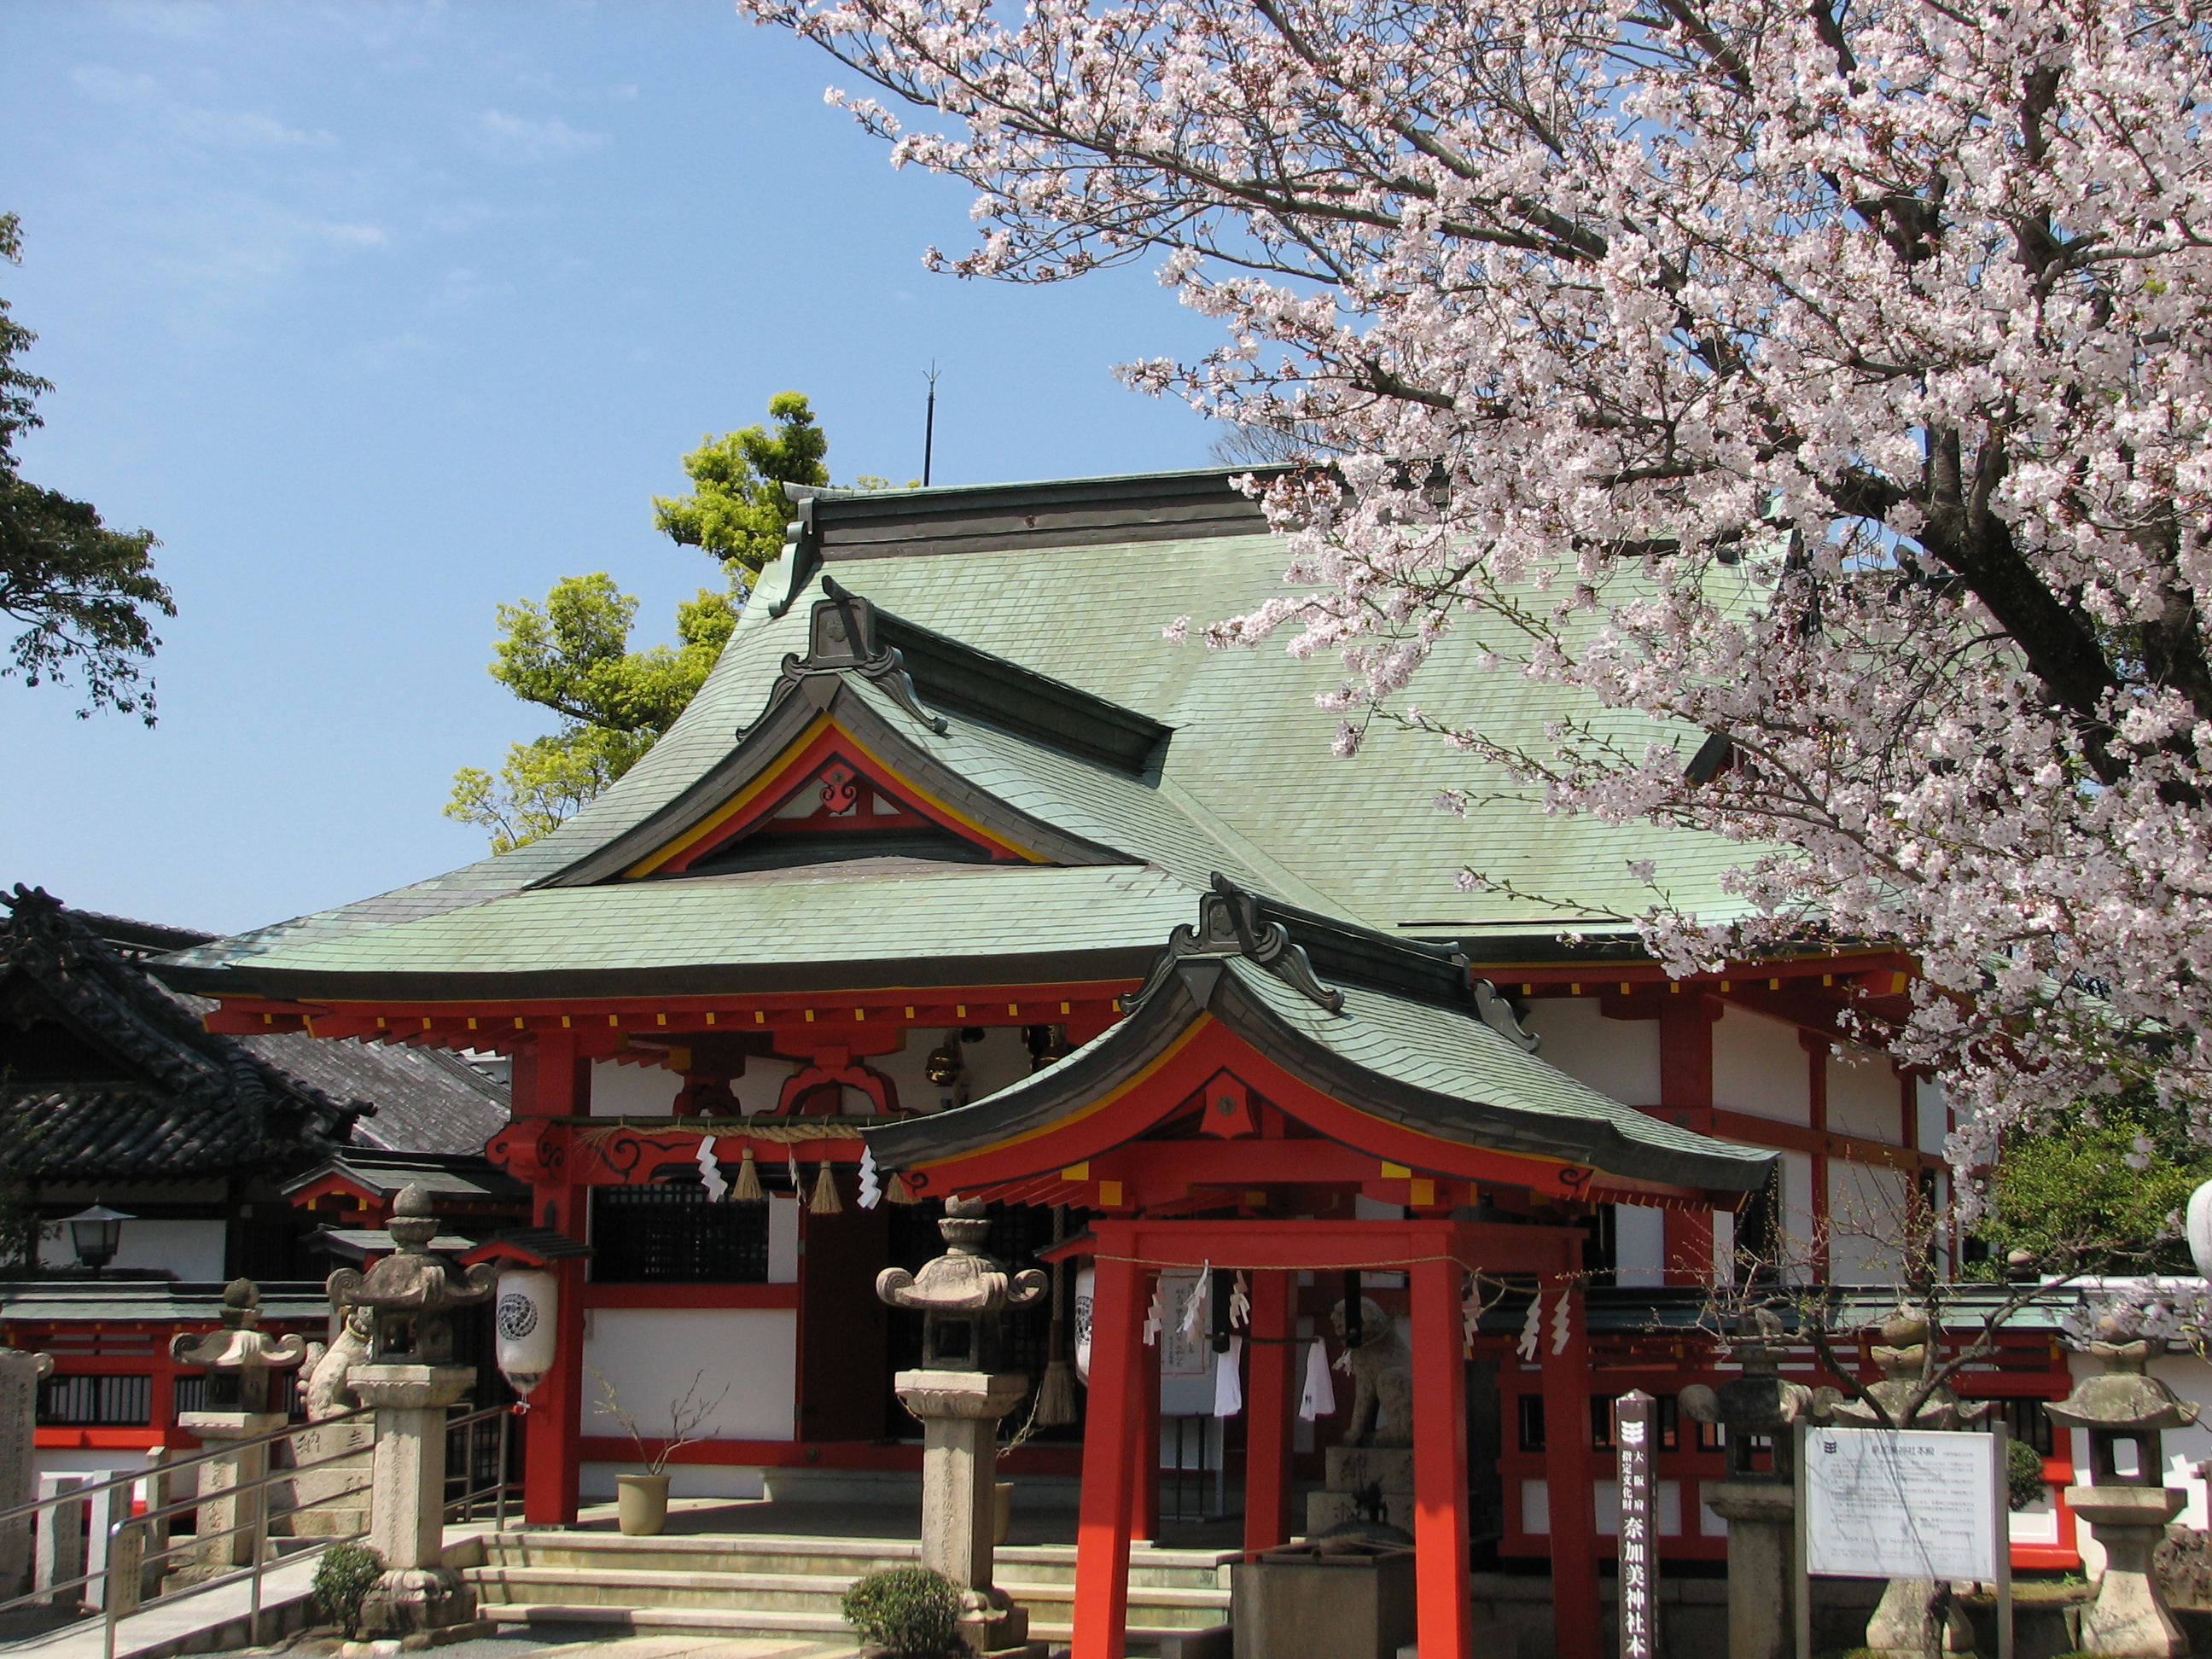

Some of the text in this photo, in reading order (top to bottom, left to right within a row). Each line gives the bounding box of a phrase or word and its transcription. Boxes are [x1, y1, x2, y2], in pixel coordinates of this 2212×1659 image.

[1621, 1450, 1633, 1511] 指定文化財
[1633, 1451, 1644, 1511] 大阪府
